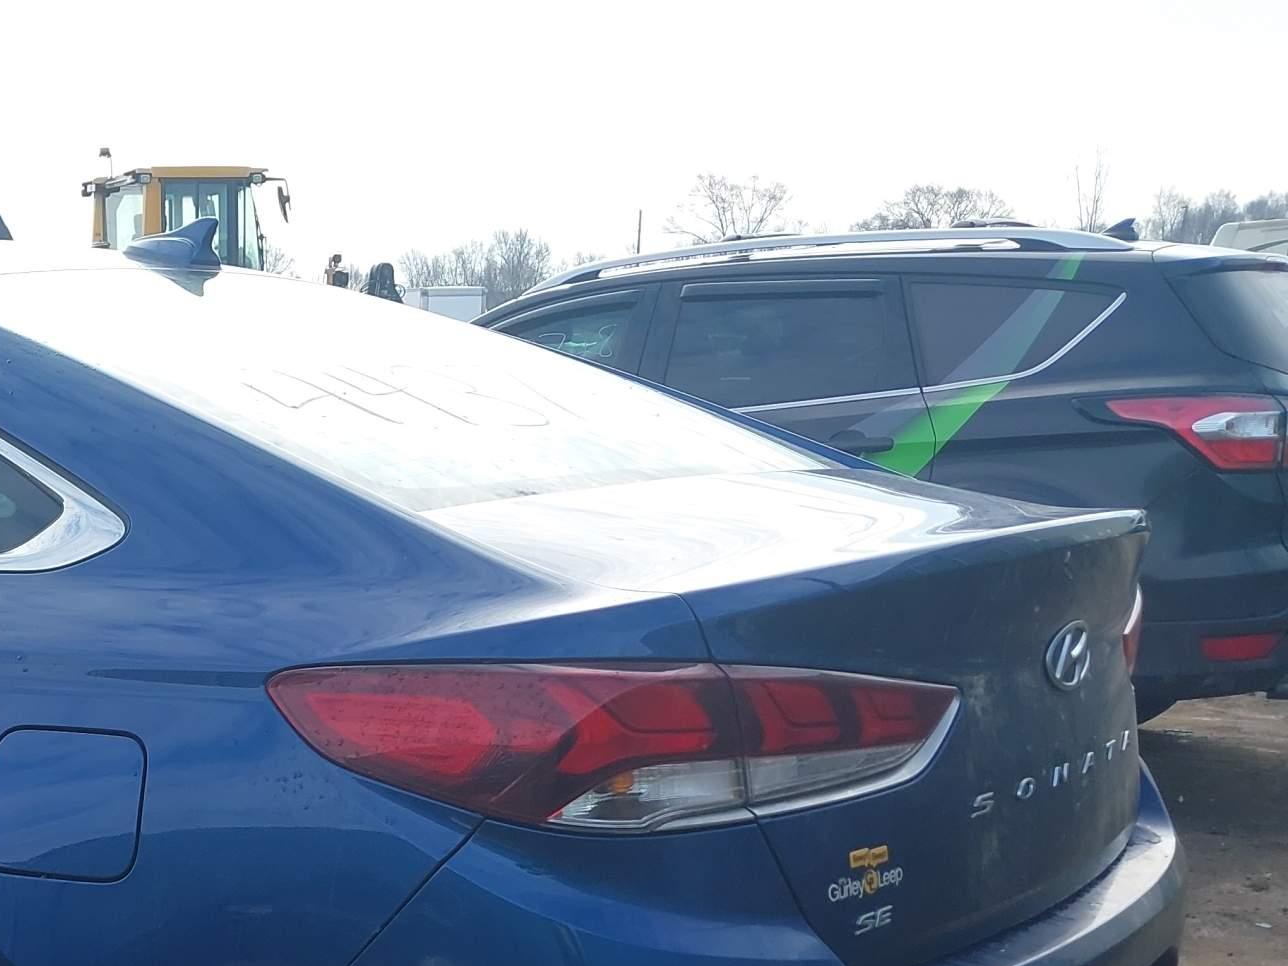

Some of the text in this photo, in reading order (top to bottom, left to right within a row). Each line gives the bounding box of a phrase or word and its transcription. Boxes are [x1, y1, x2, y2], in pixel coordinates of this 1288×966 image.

[970, 730, 1130, 818] SONATA
[877, 867, 903, 888] Leep
[854, 904, 893, 935] SE
